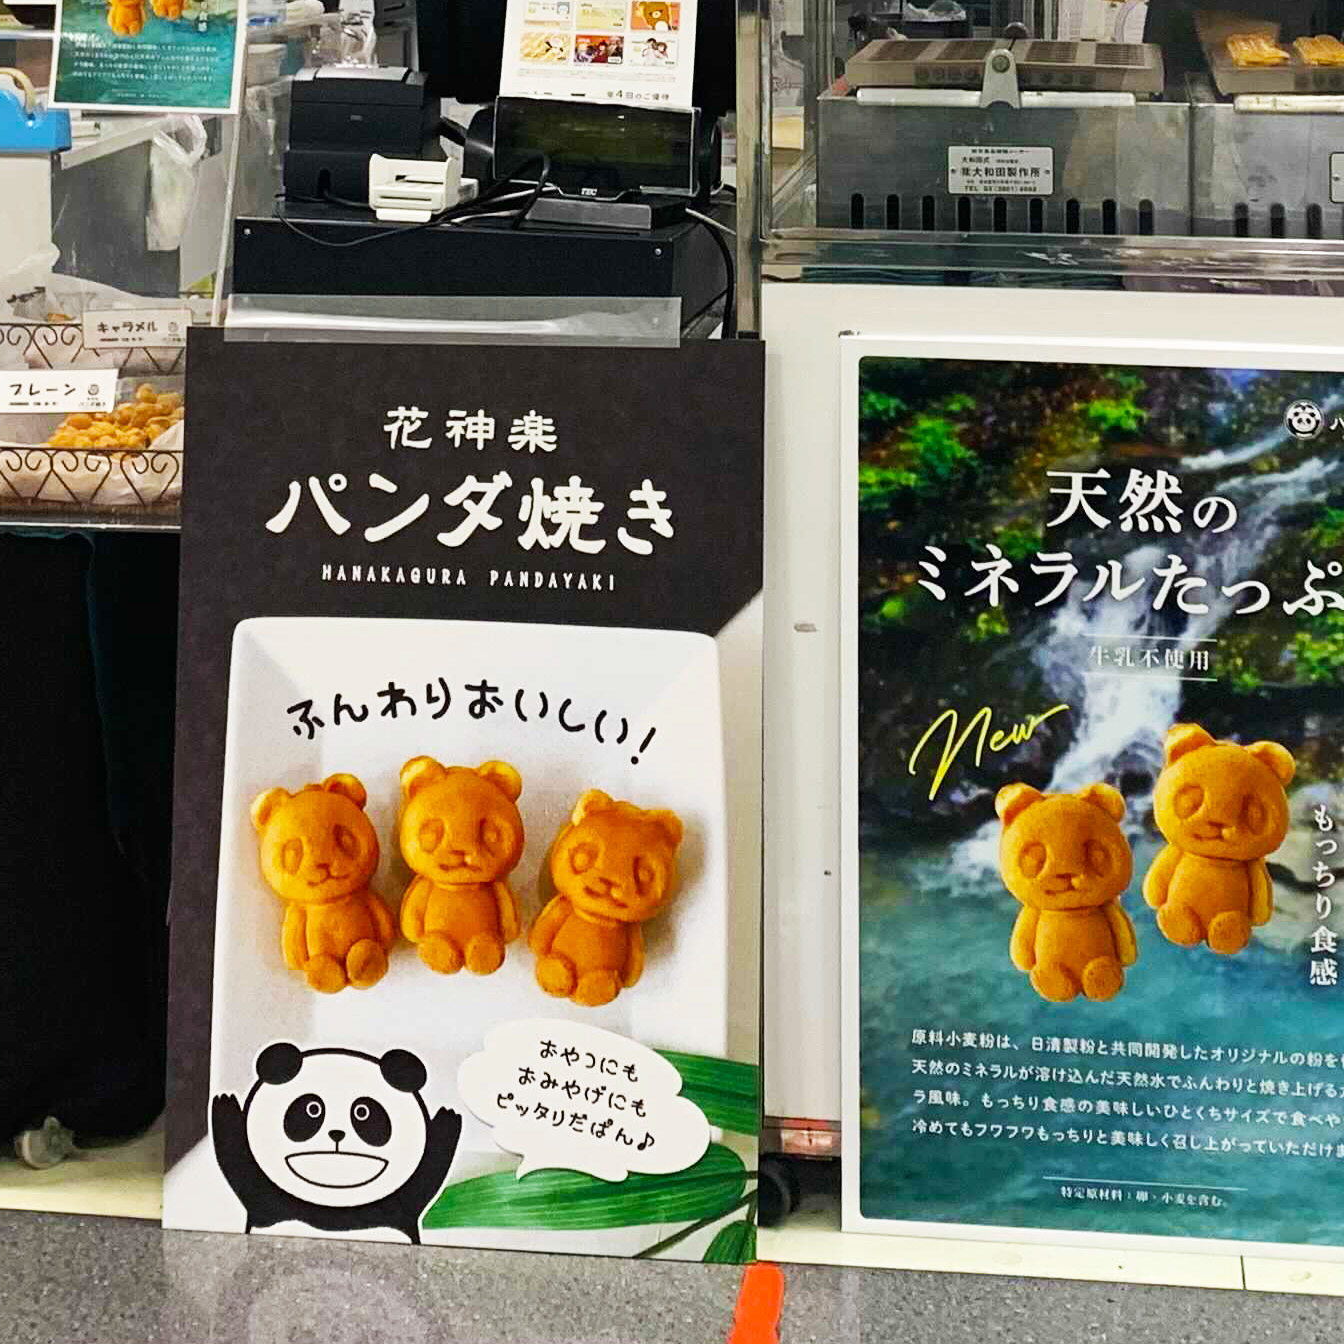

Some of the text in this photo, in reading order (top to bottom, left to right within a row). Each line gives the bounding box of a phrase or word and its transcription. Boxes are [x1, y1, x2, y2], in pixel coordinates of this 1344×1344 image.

[96, 320, 159, 334] キャラメル
[383, 405, 558, 454] 花神楽
[264, 470, 676, 556] パンダ焼き
[1045, 467, 1239, 534] 天然の
[321, 563, 616, 592] HANAKAGURA PANDAYAKI
[1088, 644, 1211, 672] 牛乳不使用
[907, 703, 1071, 802] New
[1308, 803, 1340, 988] もっちり食感
[539, 1039, 640, 1083] おやつにも
[517, 1064, 648, 1119] おみやげにも
